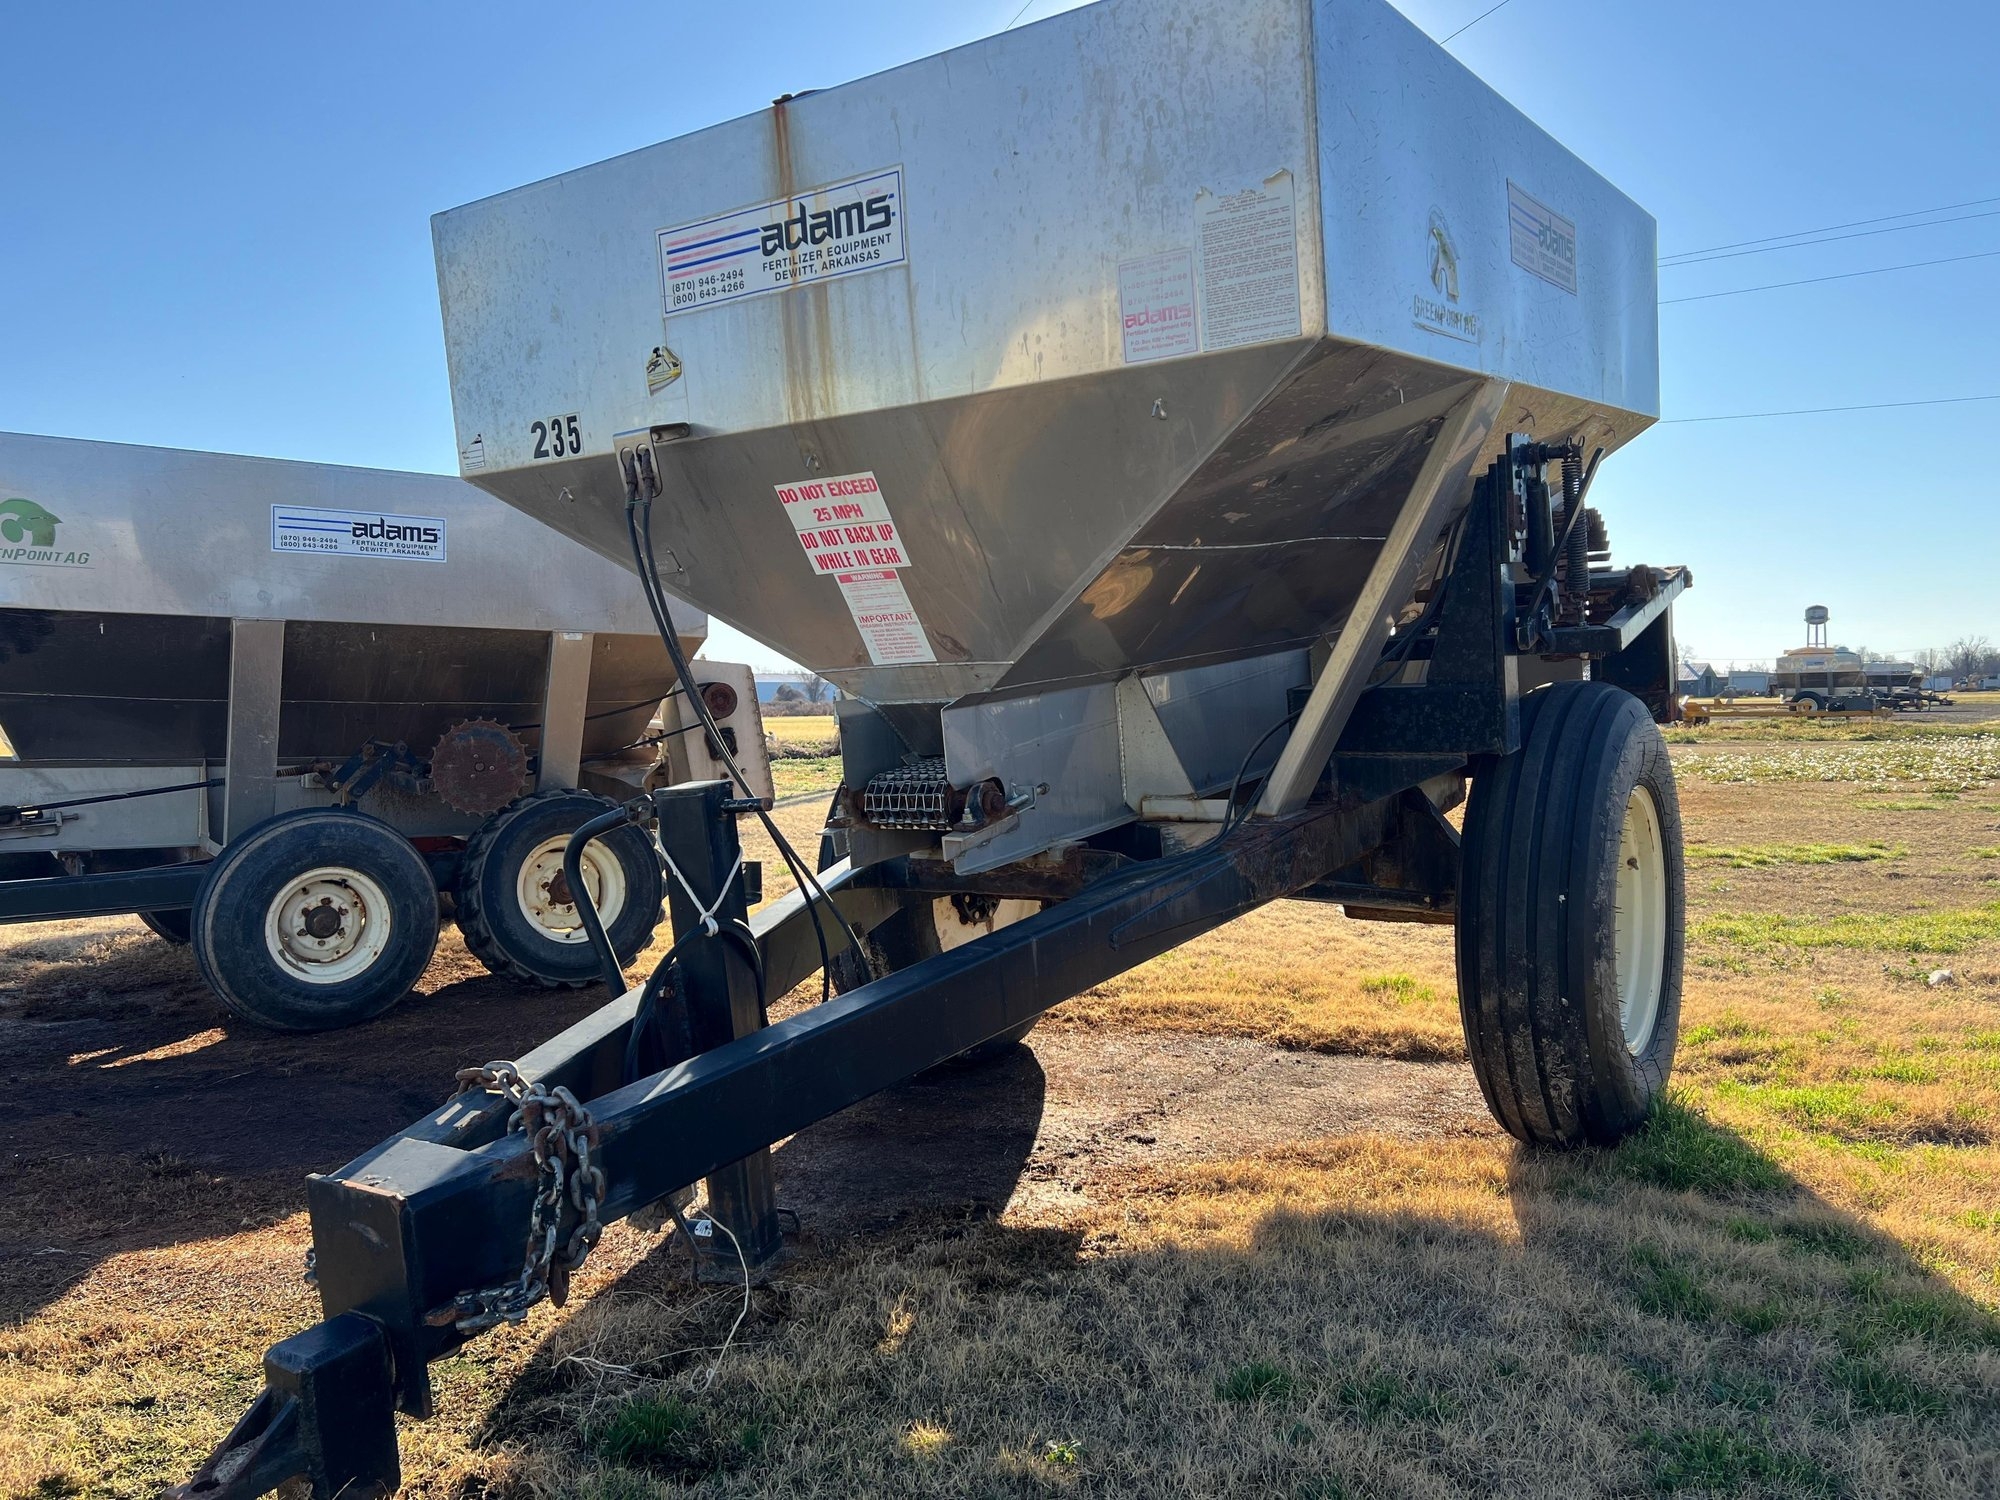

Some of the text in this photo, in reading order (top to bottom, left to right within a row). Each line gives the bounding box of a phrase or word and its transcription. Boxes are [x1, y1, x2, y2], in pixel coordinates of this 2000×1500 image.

[760, 194, 892, 257] adams
[762, 233, 892, 272] FERTILIZER EQUIPMENT
[1538, 215, 1574, 265] adams
[774, 249, 881, 282] DEWITT, ARKANSAS
[672, 269, 744, 294] (870) 946-2494
[673, 281, 745, 306] (800) 643-4266
[1124, 304, 1192, 329] adams
[530, 415, 581, 459] 235
[778, 477, 878, 504] DO NOT EXCEED
[813, 503, 864, 522] 25 MPH
[352, 517, 438, 543] adams
[800, 524, 894, 549] DO NOT BACK UP
[302, 542, 338, 550] 643-4266
[351, 539, 438, 550] FERTILIZER EQUIPMENT
[359, 546, 430, 556] DEWITT, ARKANSAS
[815, 547, 902, 571] WHILE IN GEAR
[850, 572, 885, 582] WARNING
[858, 612, 913, 624] IMPORTANT
